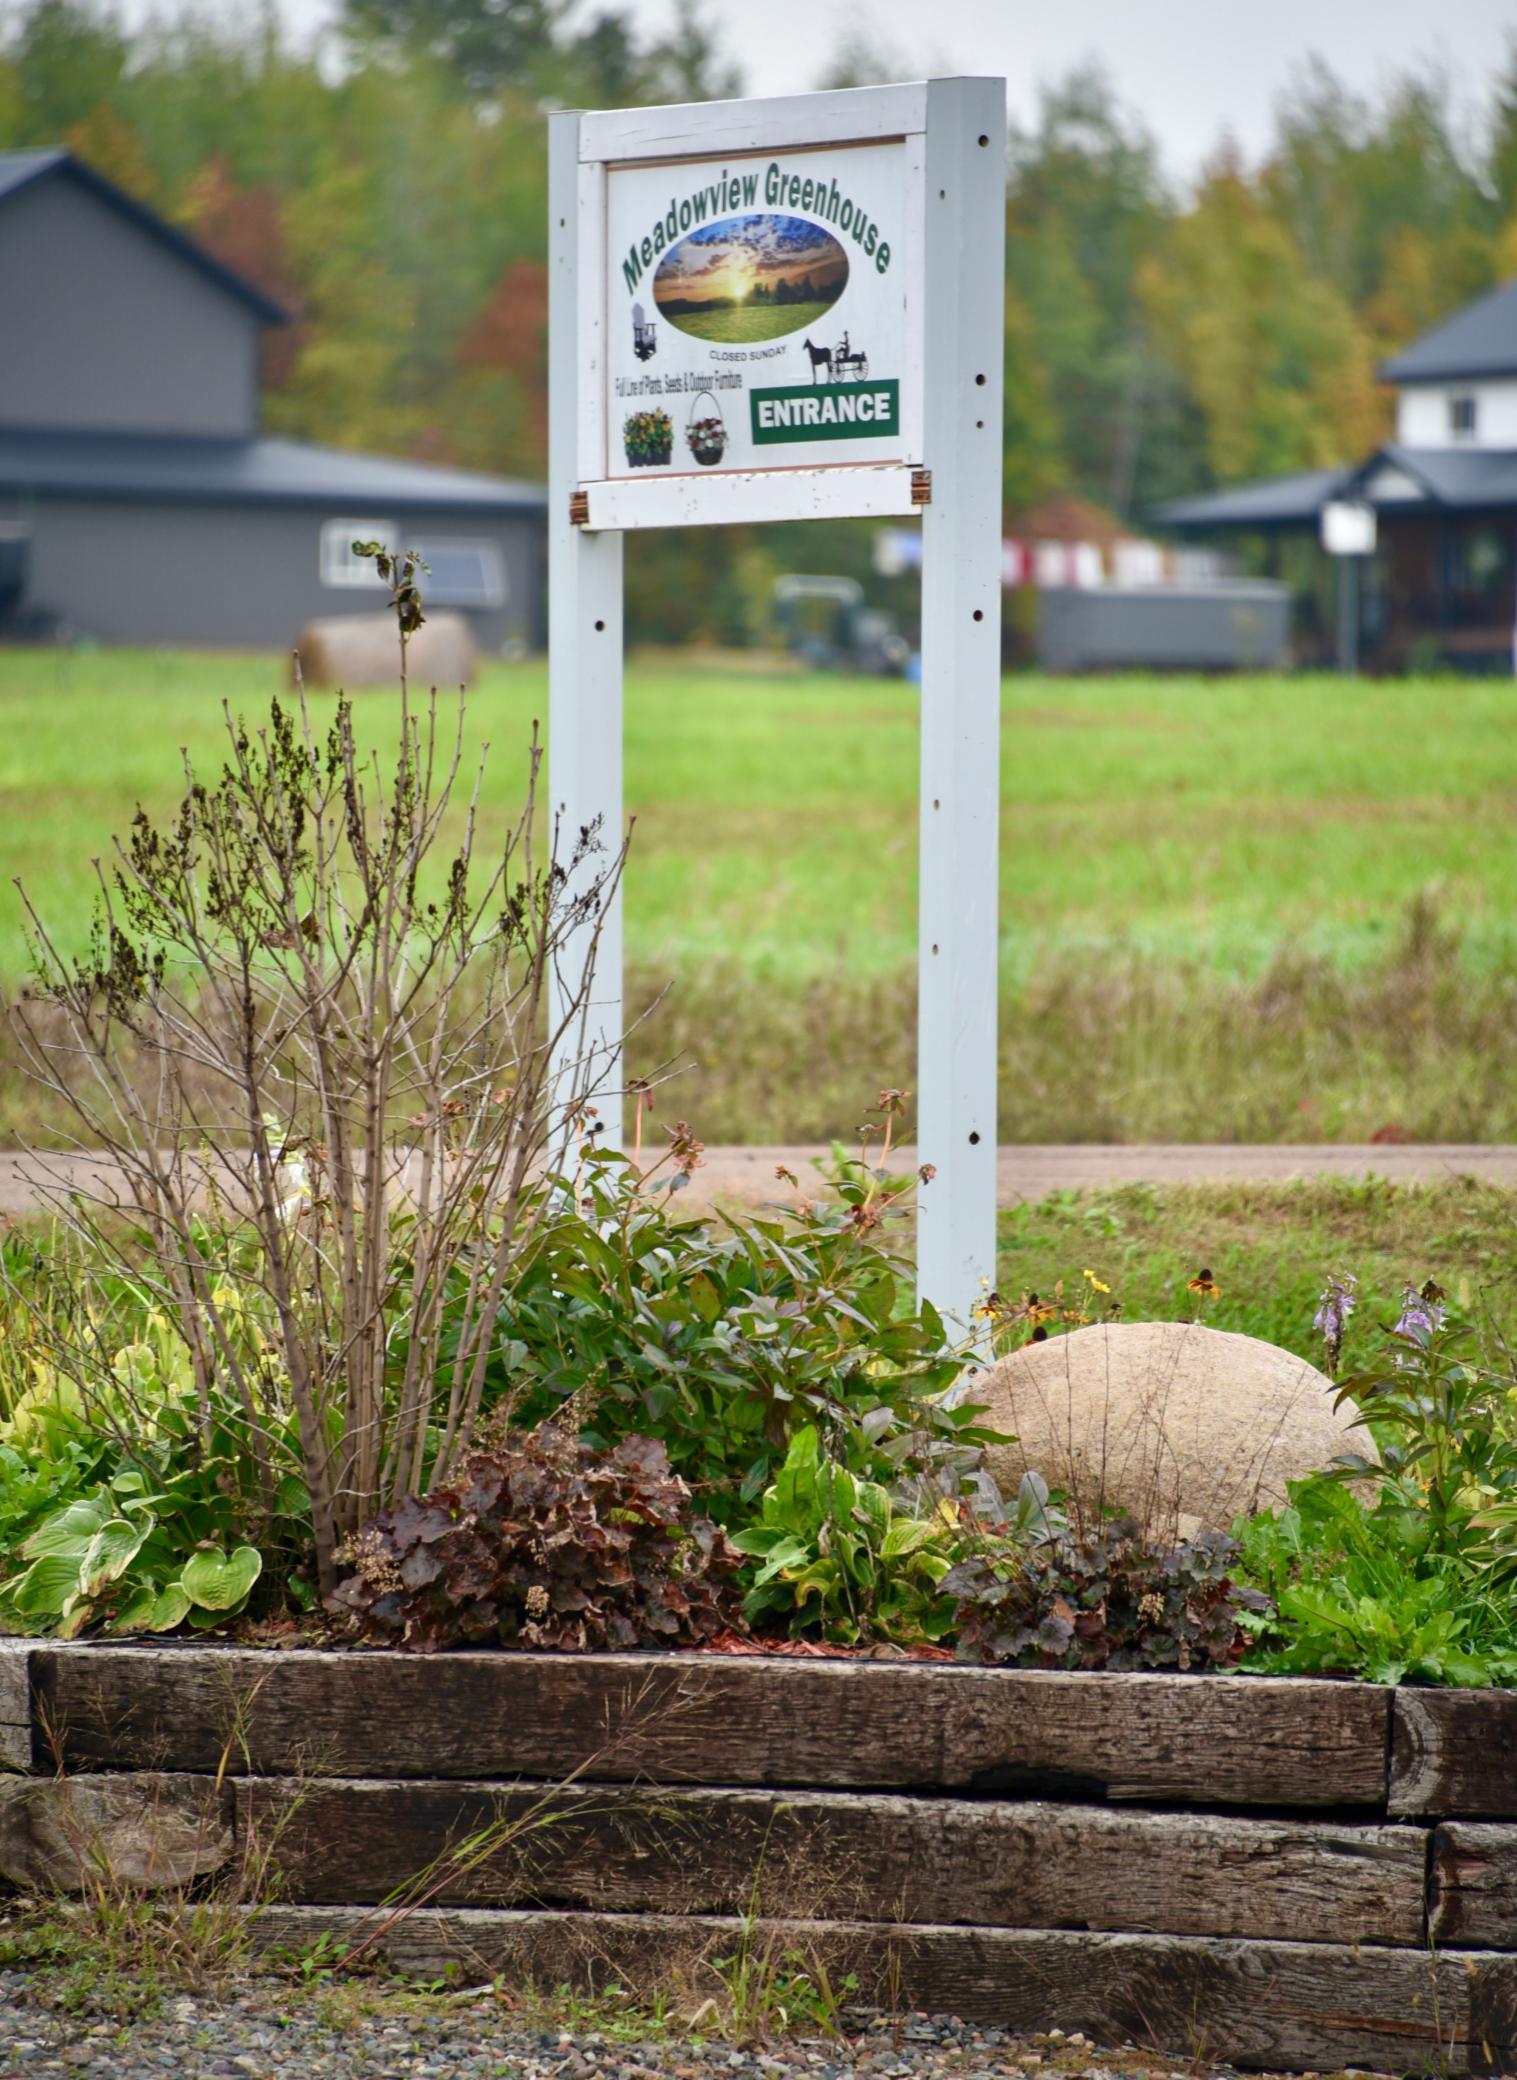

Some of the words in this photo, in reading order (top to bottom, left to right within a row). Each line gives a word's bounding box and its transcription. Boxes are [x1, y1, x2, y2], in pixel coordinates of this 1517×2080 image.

[622, 169, 759, 295] Meadowview
[765, 162, 891, 274] Greenhouse
[709, 350, 747, 362] CLOSED
[750, 344, 787, 361] SUNDAY
[757, 392, 891, 429] ENTRANCE
